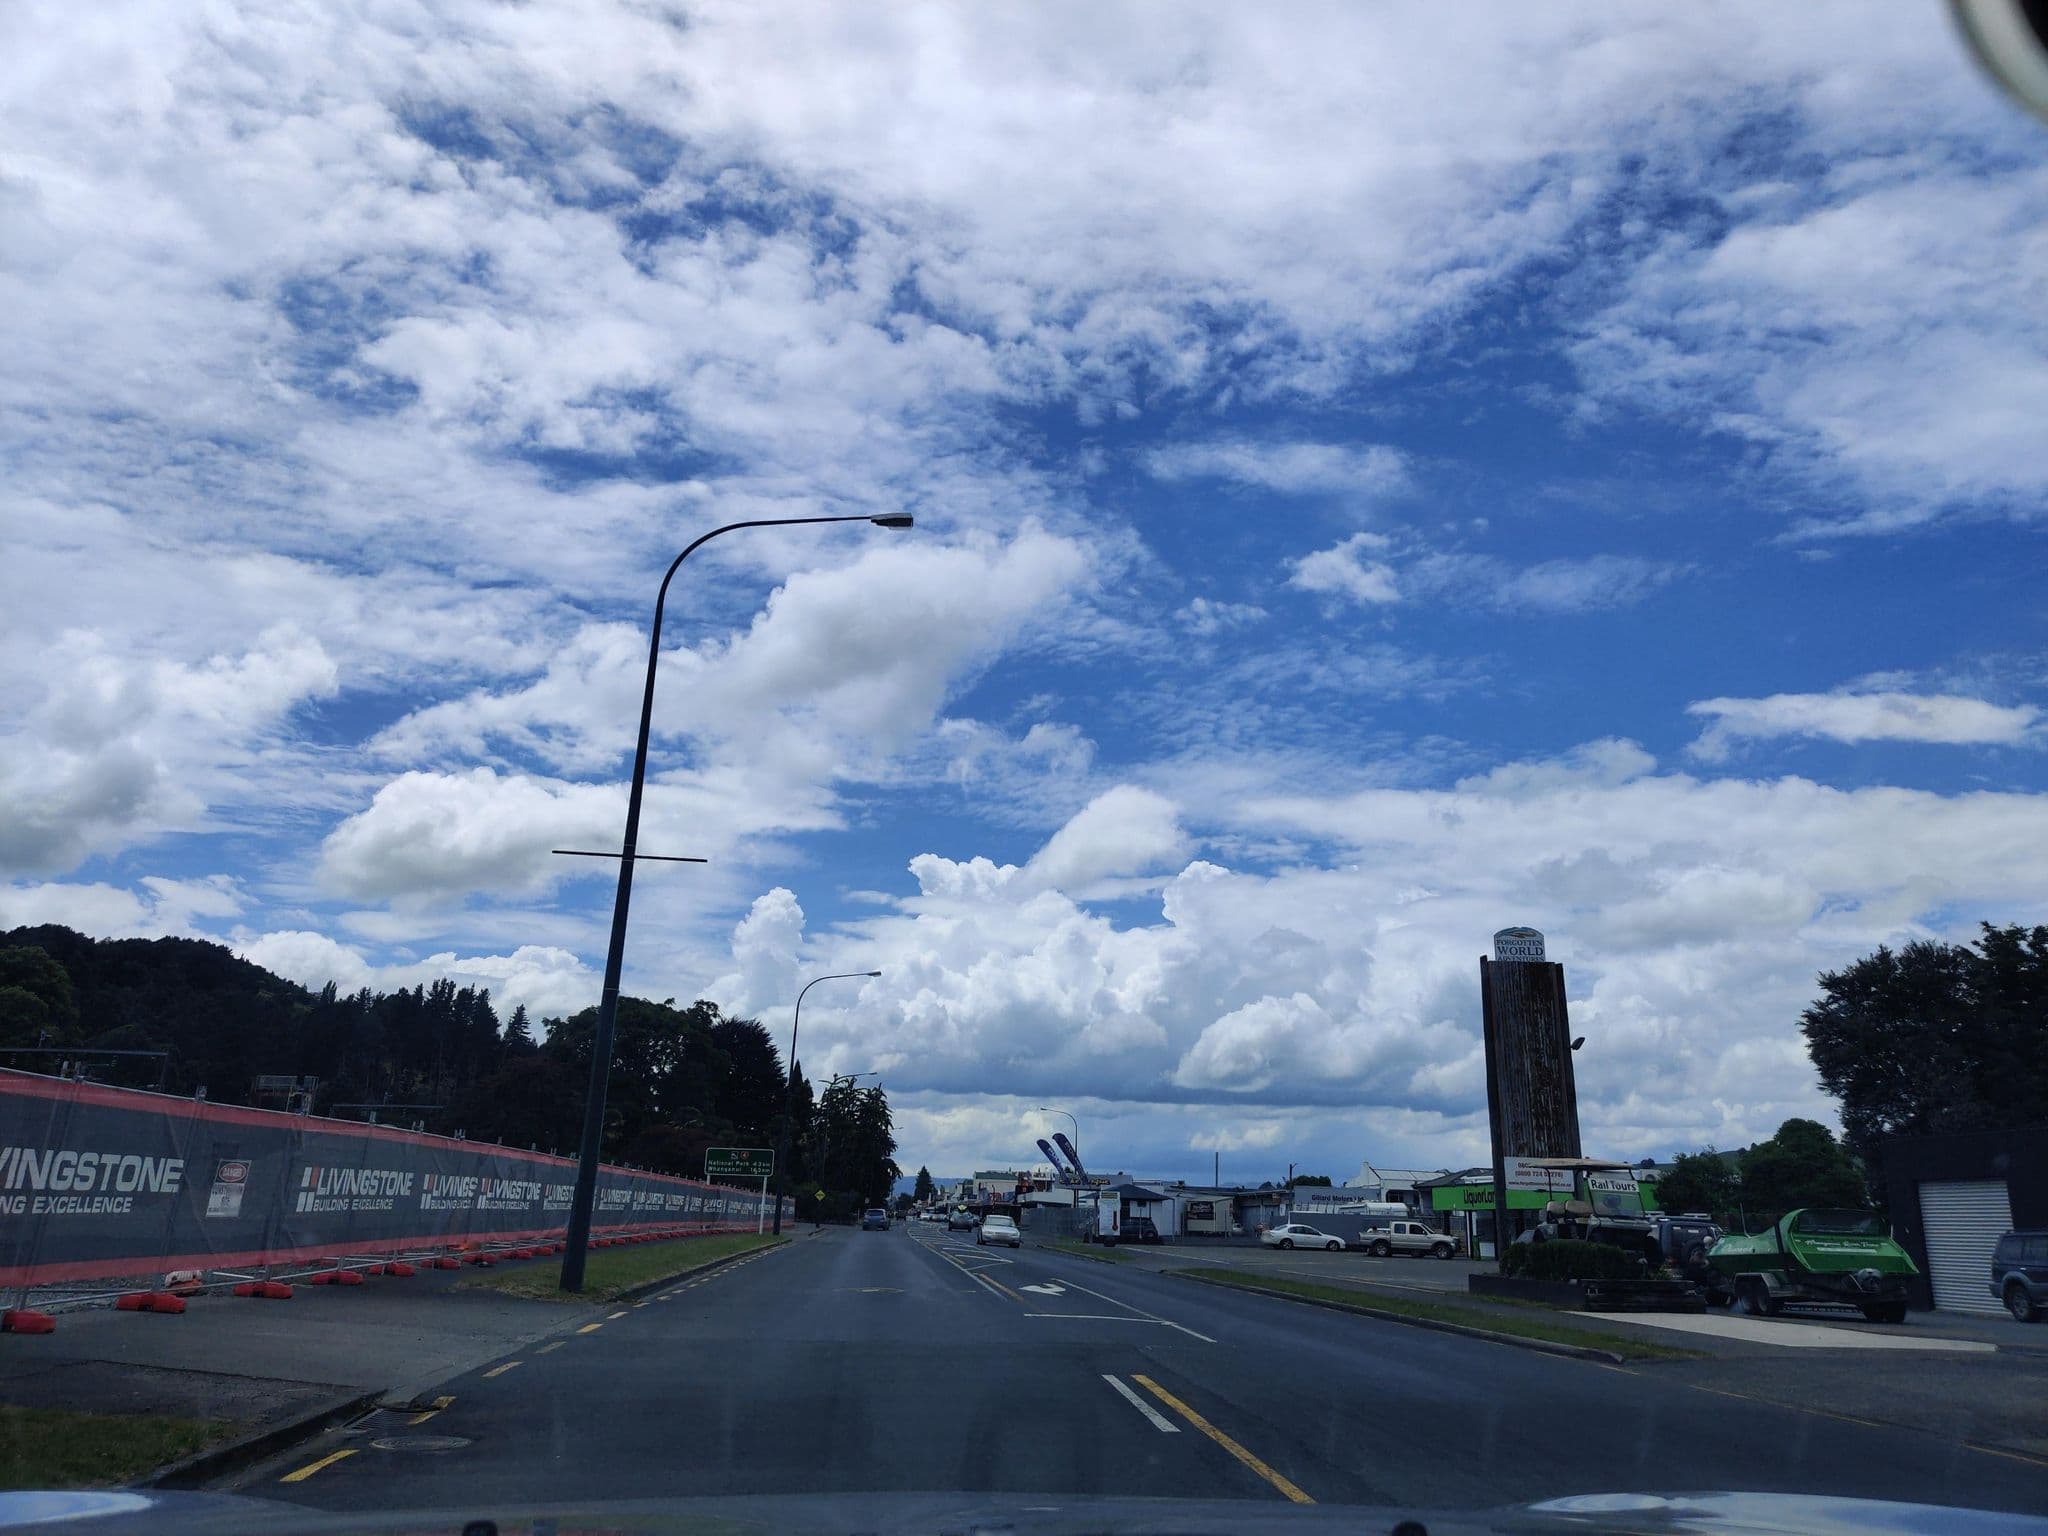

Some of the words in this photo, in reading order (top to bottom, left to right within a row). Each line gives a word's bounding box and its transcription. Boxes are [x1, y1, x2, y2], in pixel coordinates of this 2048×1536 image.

[1496, 946, 1544, 956] WORLD
[316, 1167, 414, 1197] LIVINGSTONE
[487, 1178, 542, 1200] LIVINGSTONE
[1590, 1179, 1610, 1190] Rail
[1609, 1180, 1637, 1191] Tours
[31, 1196, 134, 1214] EXCELLENCE
[312, 1198, 350, 1212] BUILDING
[351, 1198, 394, 1211] EXCELLENCE
[1332, 1195, 1353, 1203] Motors
